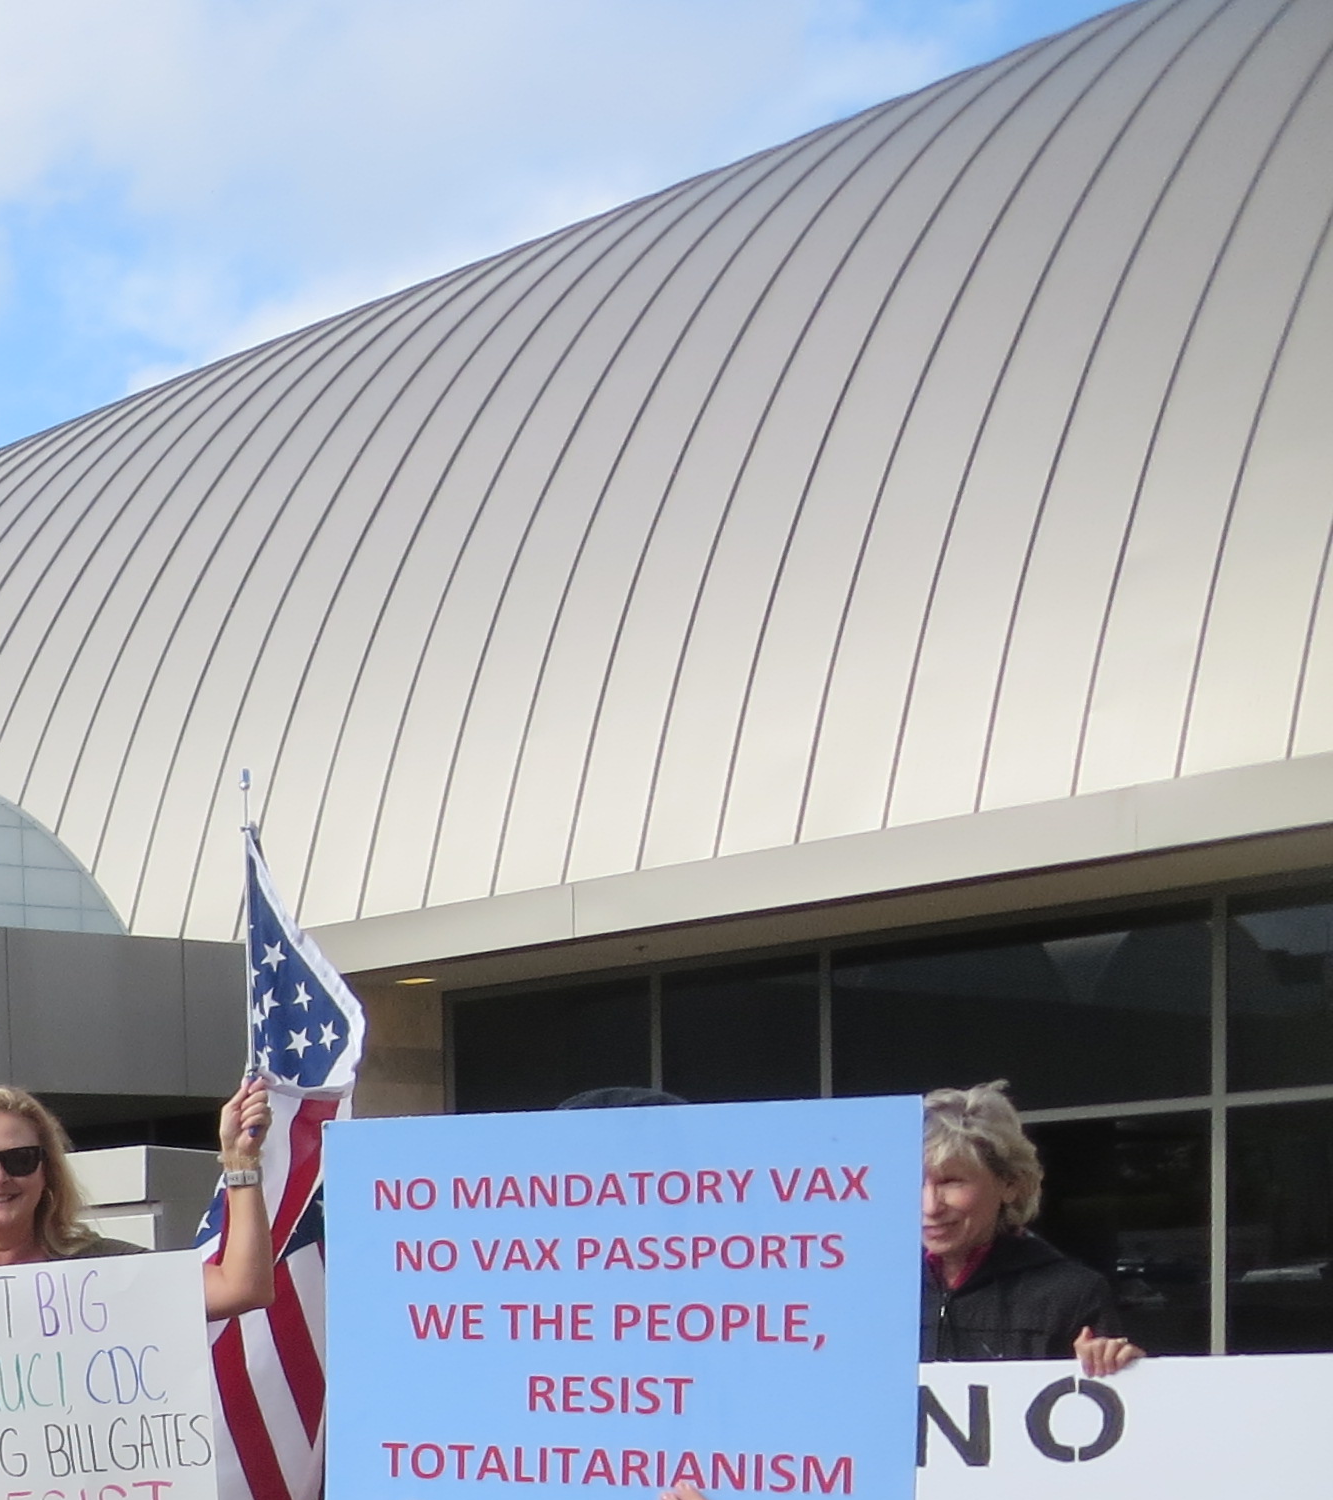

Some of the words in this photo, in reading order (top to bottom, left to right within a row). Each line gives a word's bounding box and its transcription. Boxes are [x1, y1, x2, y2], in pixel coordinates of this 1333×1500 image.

[373, 1177, 437, 1212] NO
[451, 1168, 754, 1211] MANDATORY
[769, 1165, 871, 1203] VAX
[394, 1239, 458, 1272] NO
[471, 1237, 563, 1272] VAX
[576, 1233, 846, 1271] PASSPORTS
[35, 1269, 110, 1338] BIG
[408, 1303, 485, 1340] WE
[500, 1303, 594, 1342] THE
[614, 1303, 827, 1352] PEOPLE,
[528, 1374, 694, 1416] RESIST
[916, 1376, 1127, 1467] NO
[381, 1442, 853, 1495] TOTALITARIANISM
